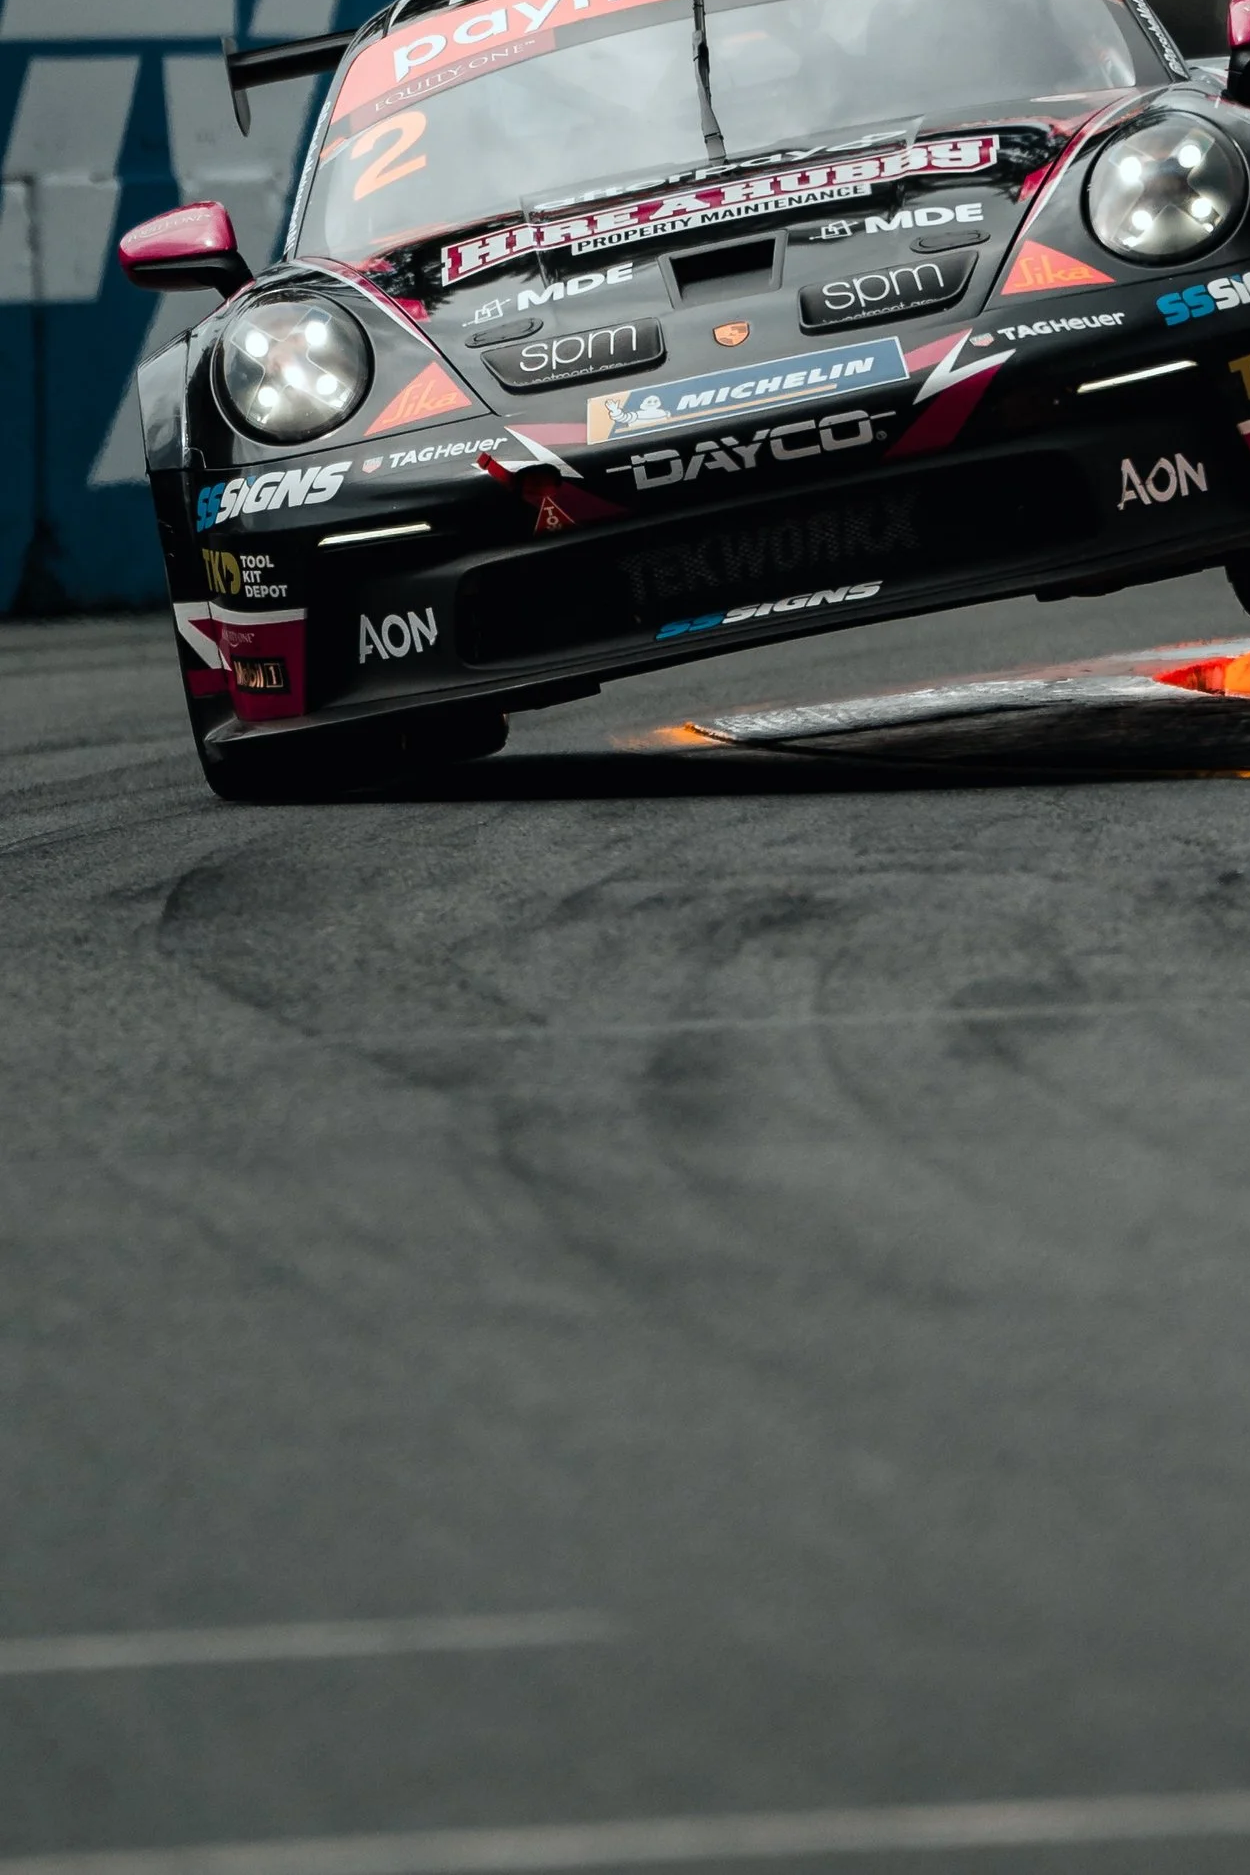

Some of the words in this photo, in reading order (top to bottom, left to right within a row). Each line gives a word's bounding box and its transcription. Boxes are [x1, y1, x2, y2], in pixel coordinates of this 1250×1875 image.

[375, 67, 464, 113] EQUITY
[350, 110, 427, 202] 2
[457, 206, 640, 275] HIRE
[650, 193, 711, 220] A
[720, 139, 984, 205] HUBBY
[577, 216, 692, 253] PROPERTY
[701, 183, 866, 224] MAINTENANCE
[864, 202, 984, 234] MDE
[516, 262, 634, 312] MDE
[821, 262, 945, 310] spm
[1013, 253, 1092, 289] Sika
[519, 325, 638, 372] spm
[381, 379, 458, 424] Sika
[676, 356, 875, 411] MICHELIN
[1117, 452, 1208, 511] AON
[202, 547, 241, 595] TKD
[240, 554, 275, 569] TOOL
[242, 570, 262, 584] KIT
[244, 584, 288, 598] DEPOT
[359, 606, 438, 665] AON
